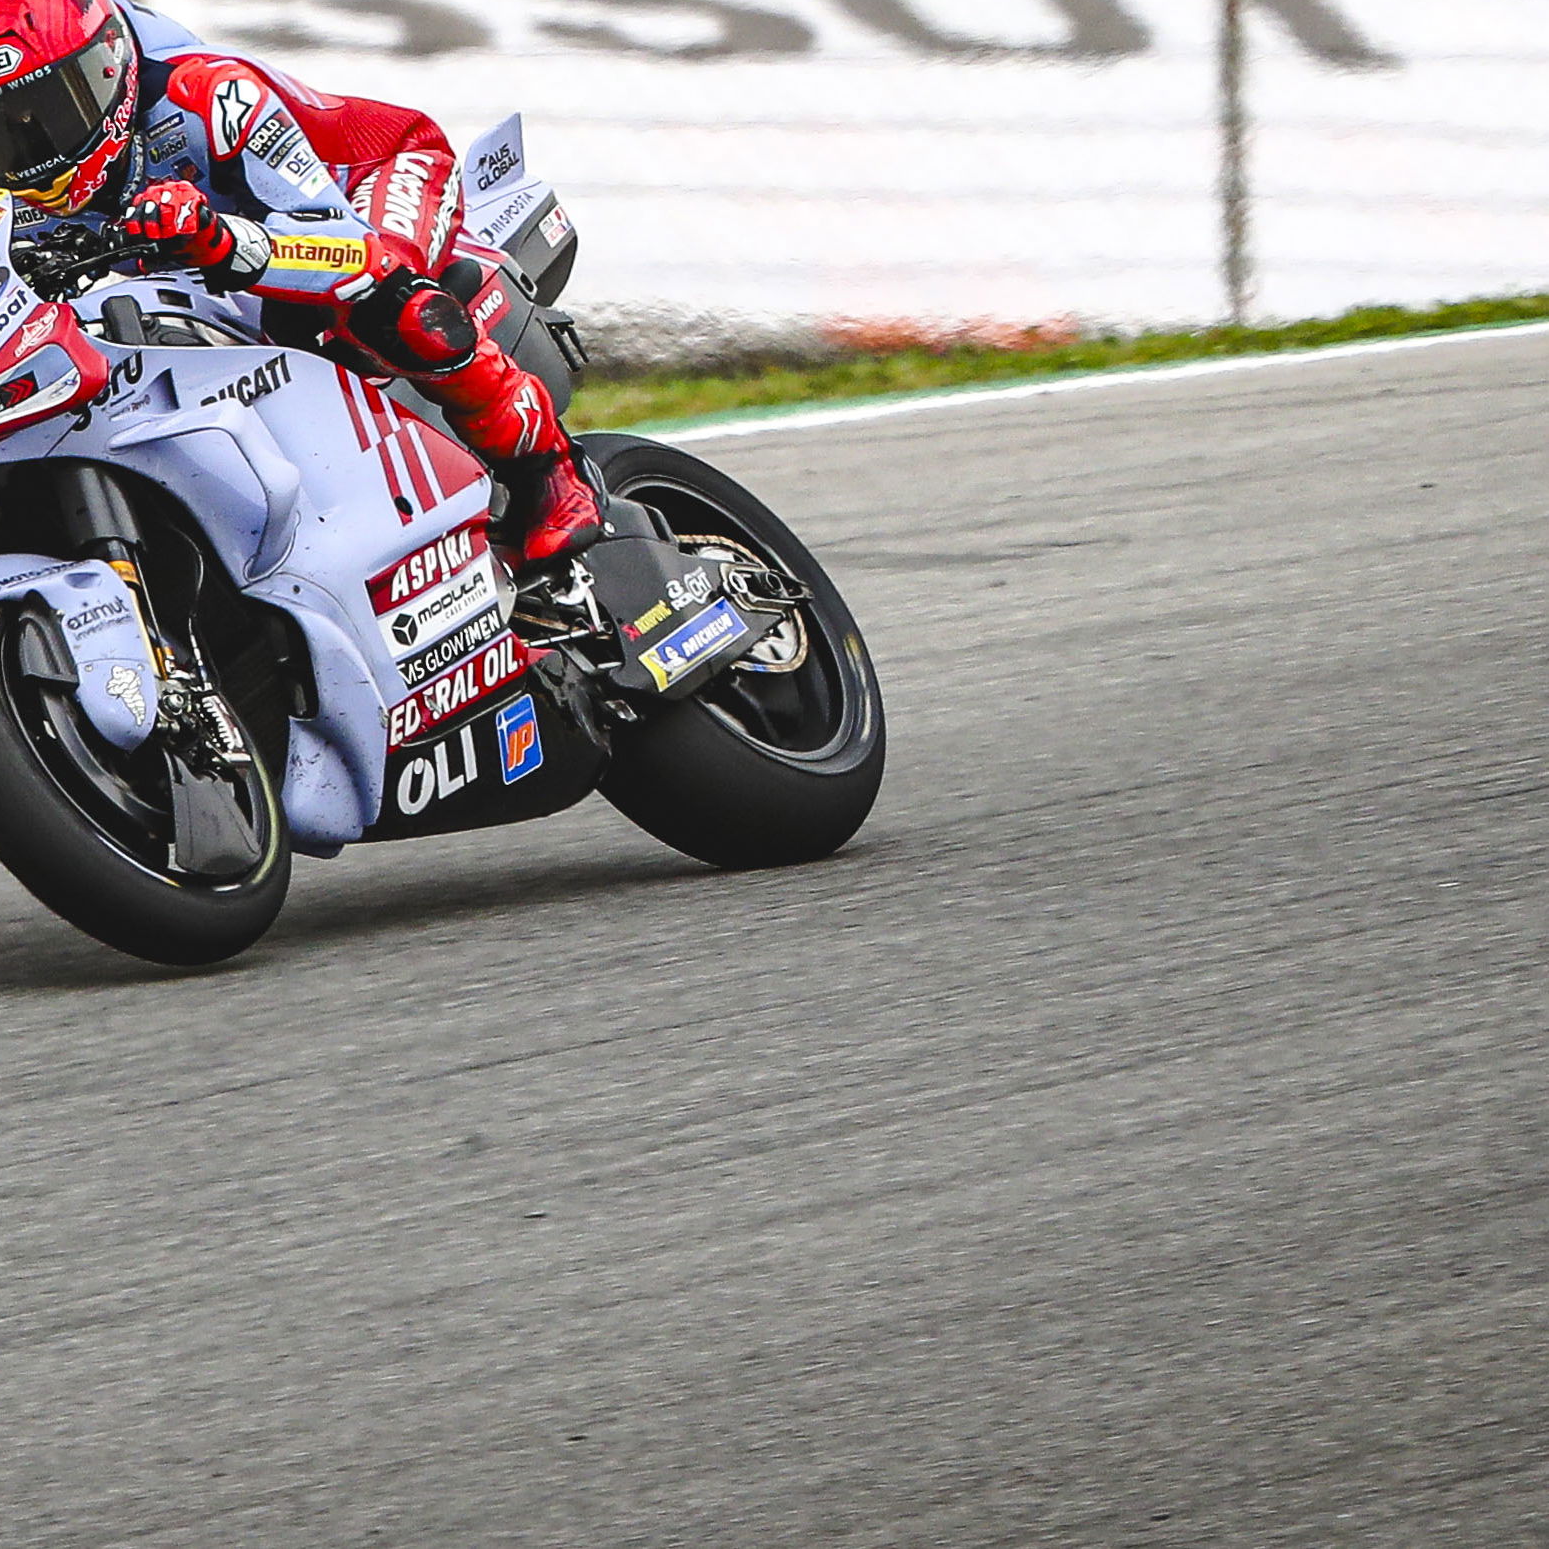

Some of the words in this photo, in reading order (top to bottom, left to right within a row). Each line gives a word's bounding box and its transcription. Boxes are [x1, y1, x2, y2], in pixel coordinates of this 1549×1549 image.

[7, 64, 52, 90] WINGS
[247, 118, 281, 152] BOLD
[16, 154, 67, 179] VERTICAL
[477, 152, 520, 192] GLOBAL
[381, 151, 435, 240] DUCATI
[491, 191, 535, 235] RISPOSTA
[270, 238, 363, 268] Antangin
[66, 595, 130, 631] azimut
[418, 572, 485, 625] MODULA
[390, 666, 479, 747] EDRAL
[483, 636, 519, 688] OIL
[506, 720, 535, 772] IP
